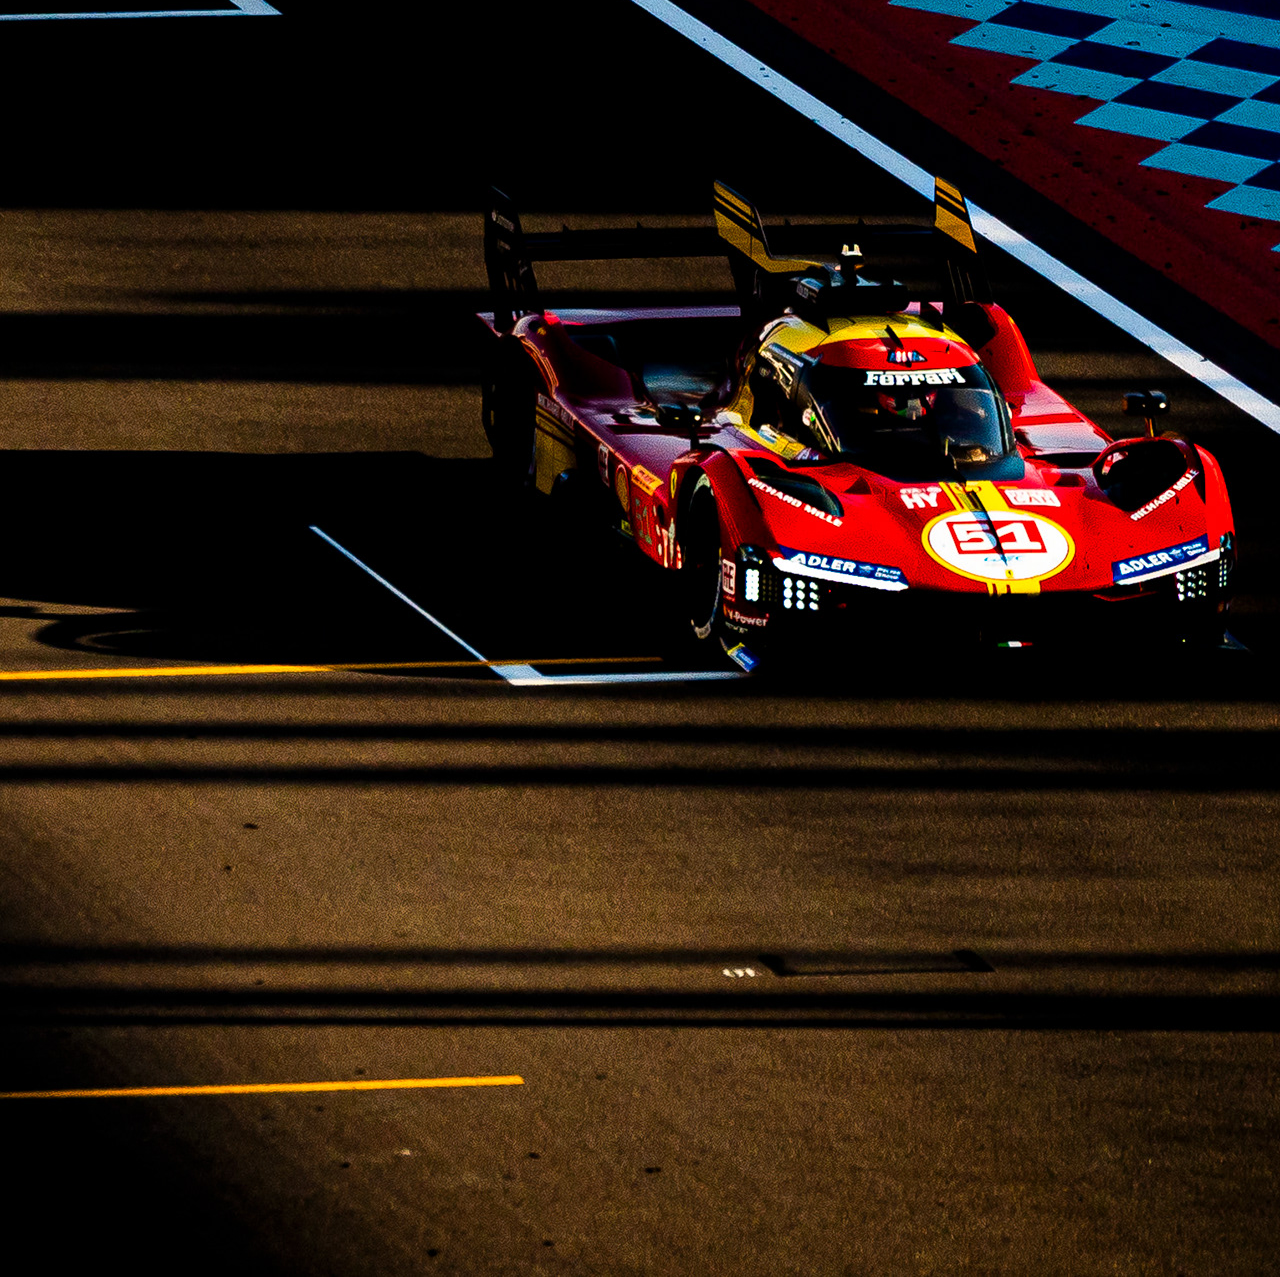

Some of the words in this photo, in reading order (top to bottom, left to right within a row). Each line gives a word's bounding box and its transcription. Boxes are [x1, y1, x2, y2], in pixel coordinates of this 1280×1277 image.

[863, 367, 966, 386] Ferrari
[747, 477, 803, 508] RICHARD
[803, 504, 843, 527] MILLE
[951, 522, 1043, 552] 51
[789, 553, 857, 573] ADLER
[1118, 552, 1174, 576] ADLER
